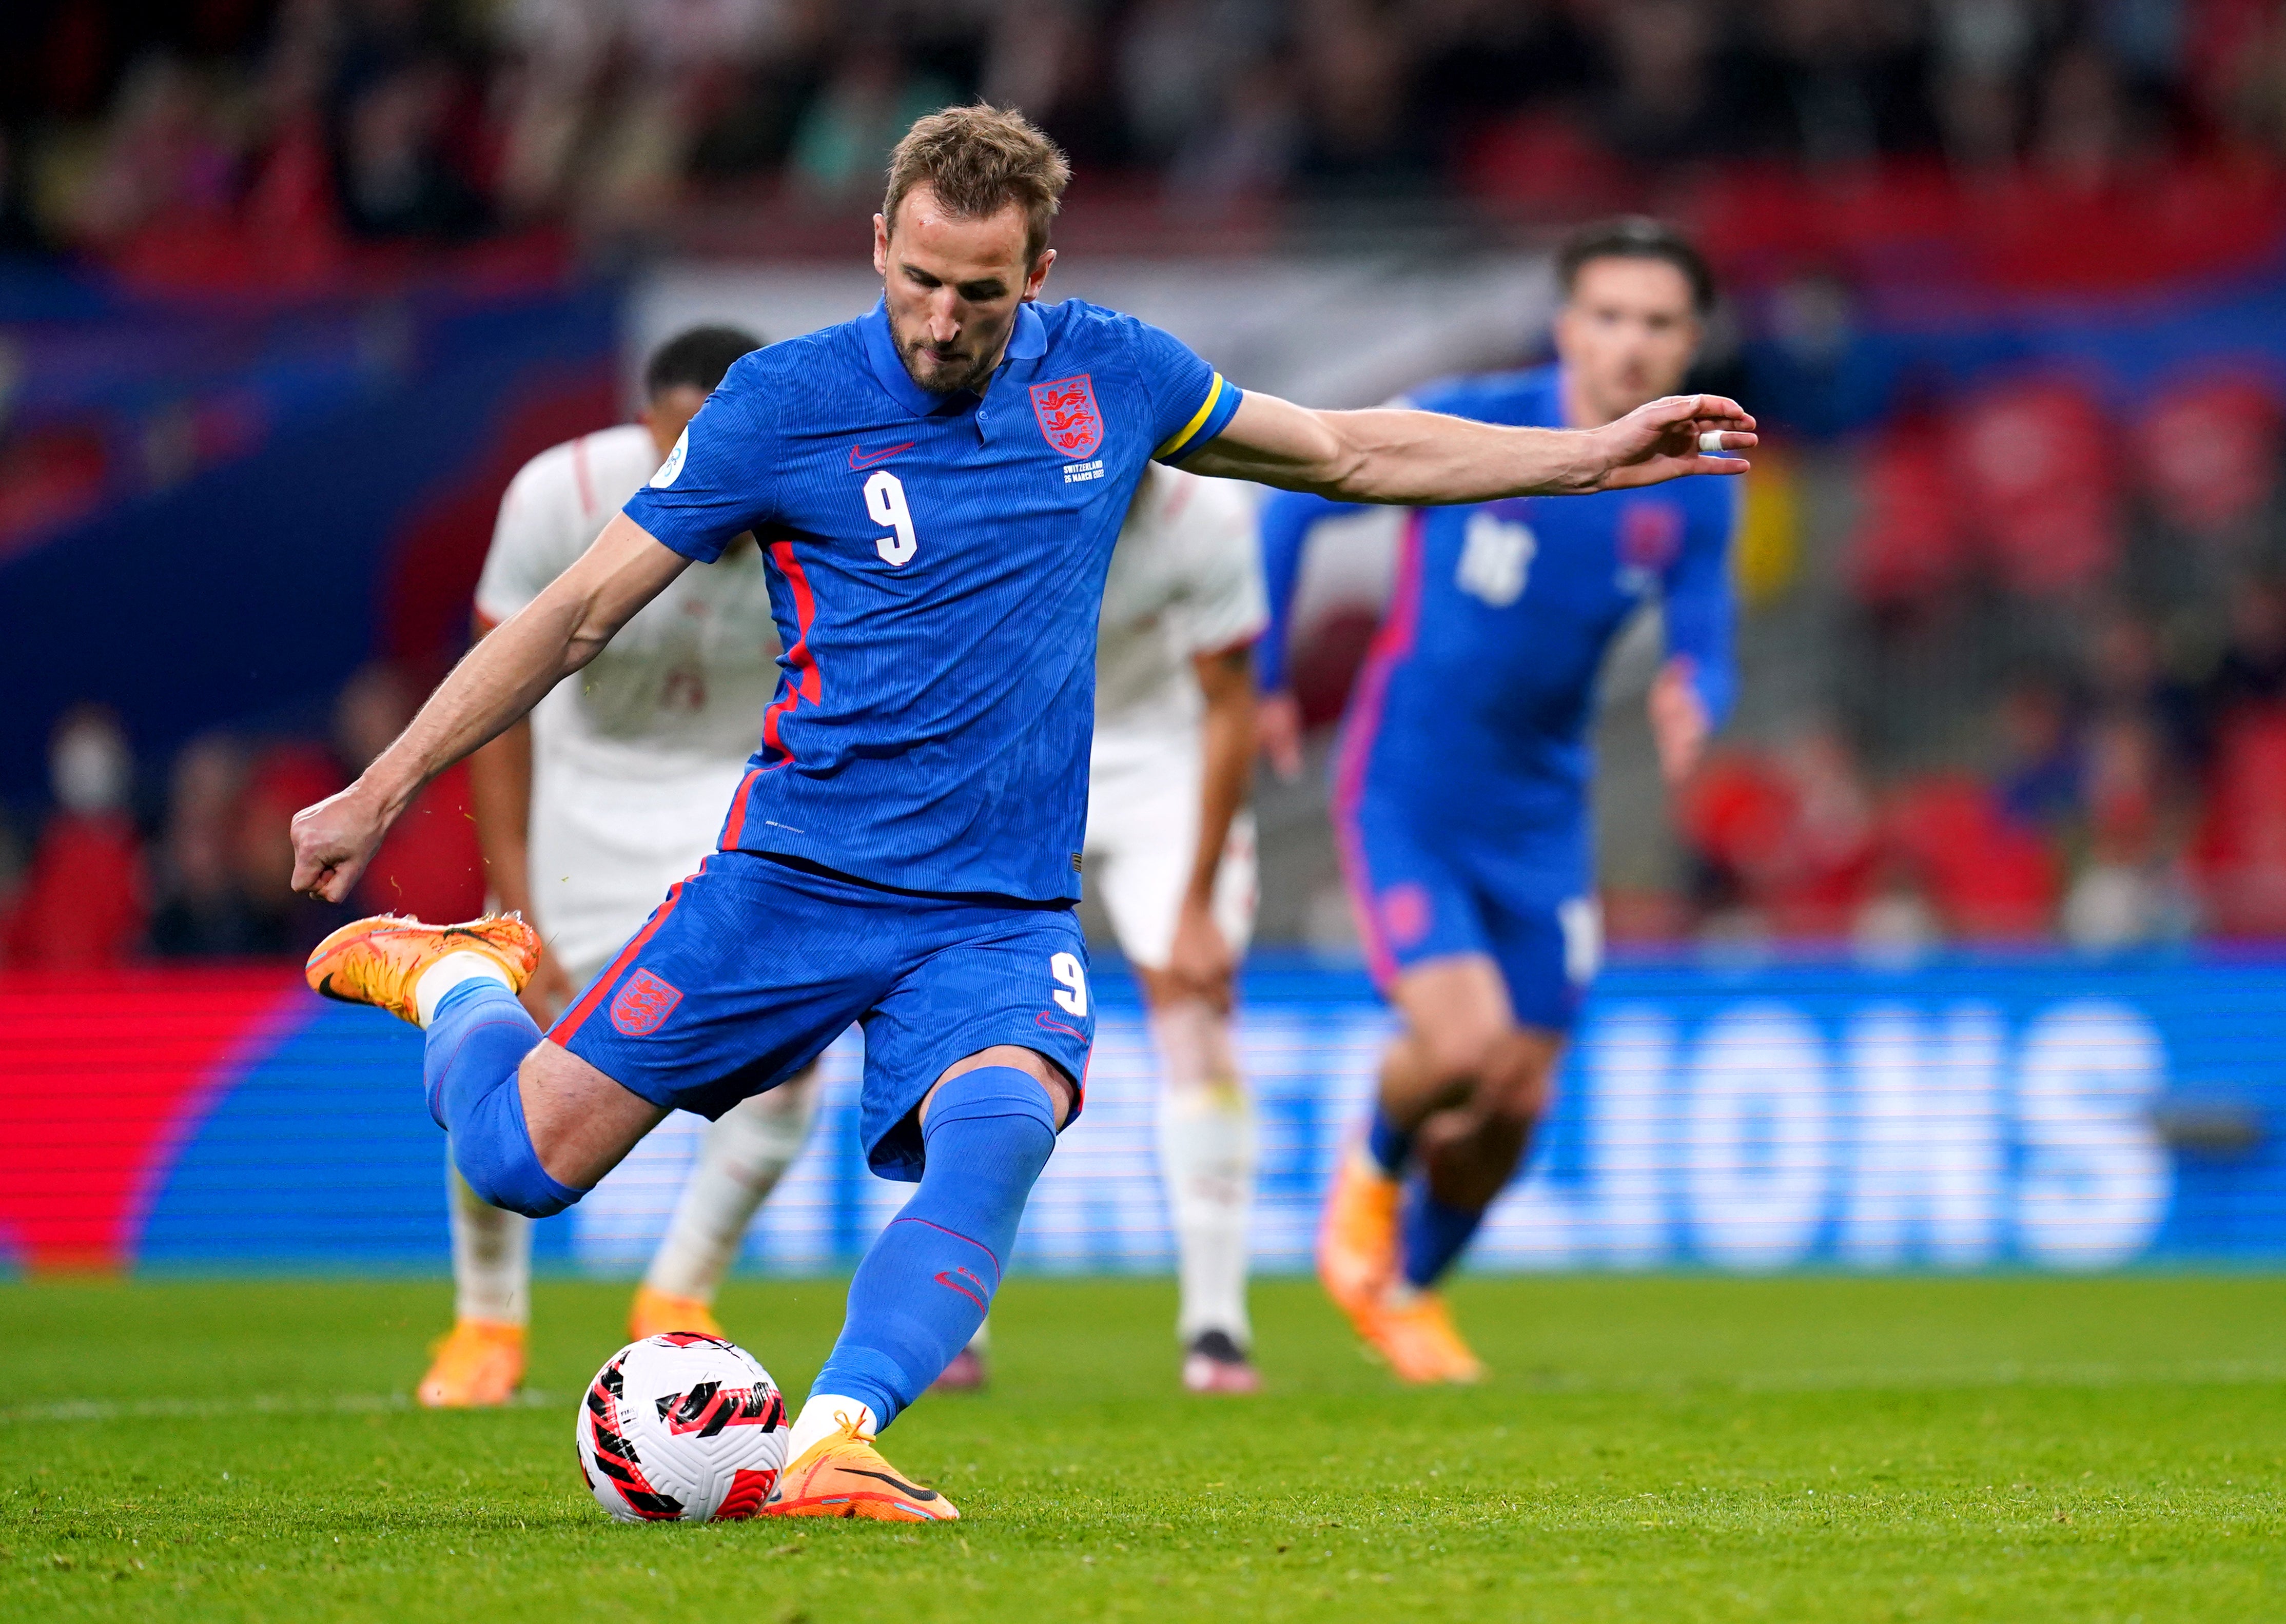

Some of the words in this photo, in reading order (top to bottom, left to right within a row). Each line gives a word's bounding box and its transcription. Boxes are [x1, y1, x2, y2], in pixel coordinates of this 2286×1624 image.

[1064, 460, 1103, 473] SWITZERLAND
[1064, 475, 1071, 483] 26
[1072, 472, 1092, 482] MARCH
[1093, 469, 1104, 479] 2022
[863, 469, 918, 566] 9
[1050, 952, 1088, 1017] 9
